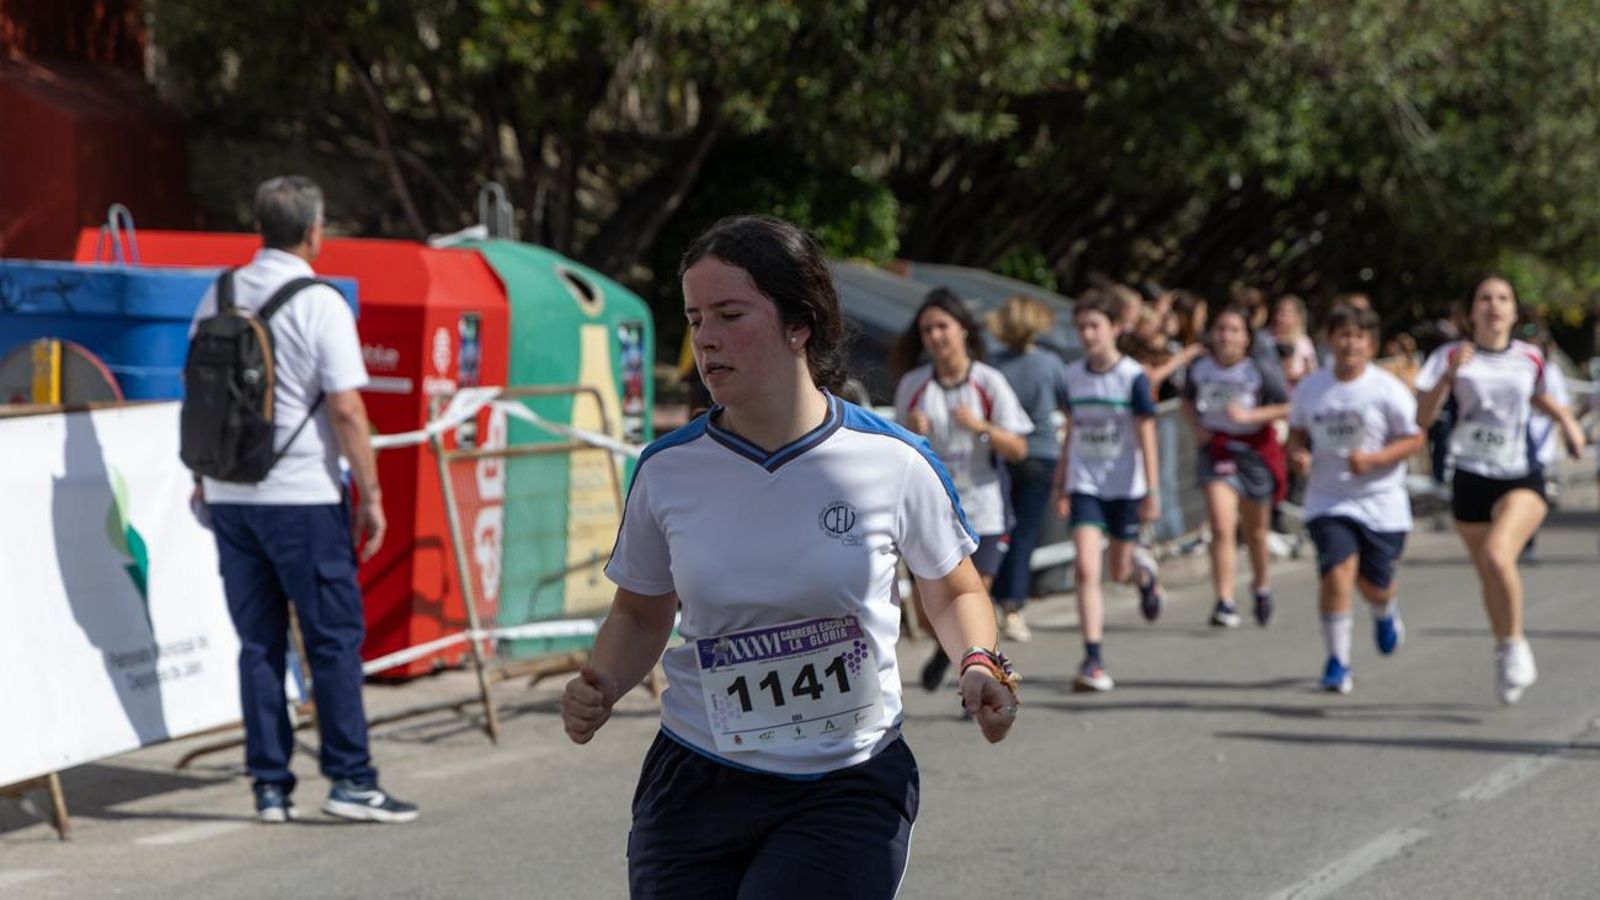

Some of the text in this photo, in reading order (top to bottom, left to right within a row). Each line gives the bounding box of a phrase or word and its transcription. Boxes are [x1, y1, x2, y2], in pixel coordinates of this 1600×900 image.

[780, 618, 856, 641] CARRERA ESCOLAR
[789, 629, 848, 651] LA GLORIA
[728, 632, 781, 660] XXXVI
[727, 656, 851, 713] 1141
